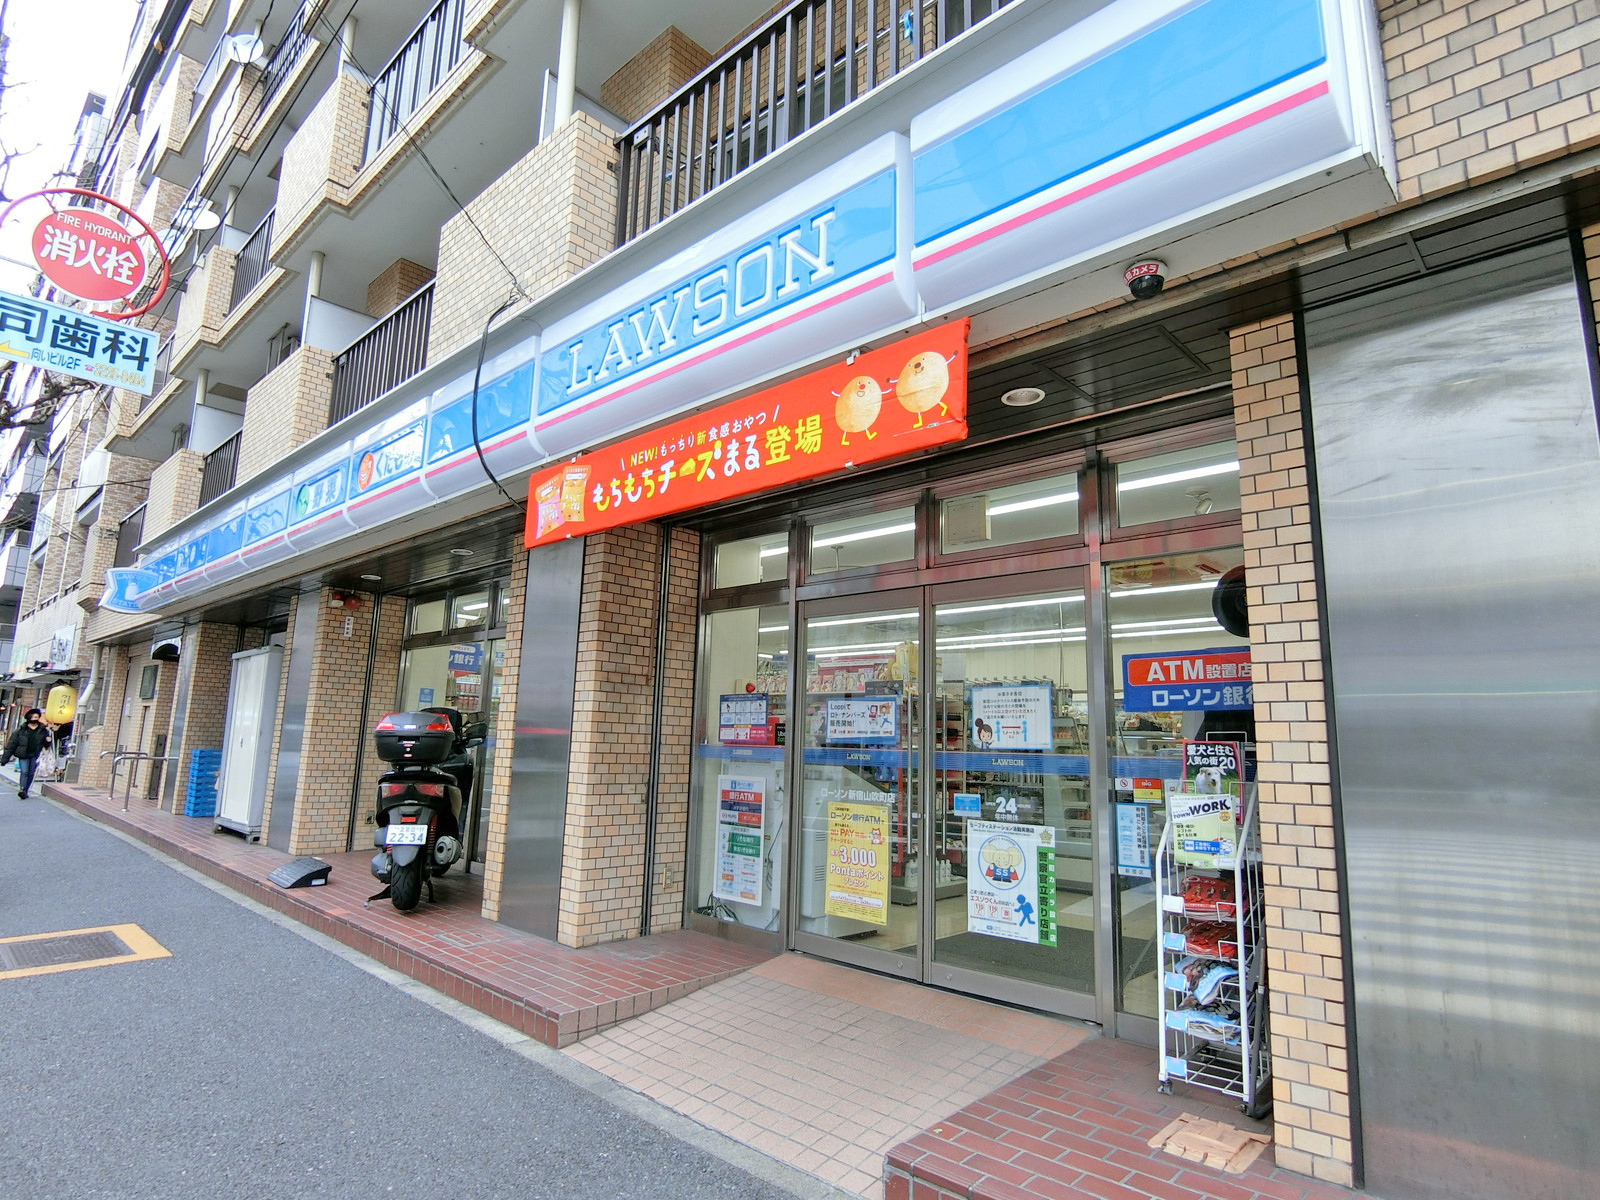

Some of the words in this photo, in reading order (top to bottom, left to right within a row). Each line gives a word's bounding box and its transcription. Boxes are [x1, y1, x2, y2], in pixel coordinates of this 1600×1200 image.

[57, 212, 80, 229] FIRE
[84, 222, 133, 245] HYDRANT
[39, 224, 139, 286] 消火栓
[566, 207, 836, 395] LAWSON
[31, 347, 82, 370] 向いビル2F
[629, 446, 658, 467] NEW!
[660, 411, 767, 458] もっちり新食感おやつ
[1186, 744, 1234, 756] 愛犬と住む
[992, 758, 1024, 766] LAWSON
[820, 788, 896, 804] ローソン新宿山吹町店
[996, 796, 1017, 814] 24
[1189, 799, 1231, 815] WORK
[389, 832, 424, 843] 22-34
[839, 845, 877, 868] 3,000
[830, 863, 884, 881] Pontaポイント
[996, 868, 1008, 877] SS
[843, 877, 869, 888] プレゼント
